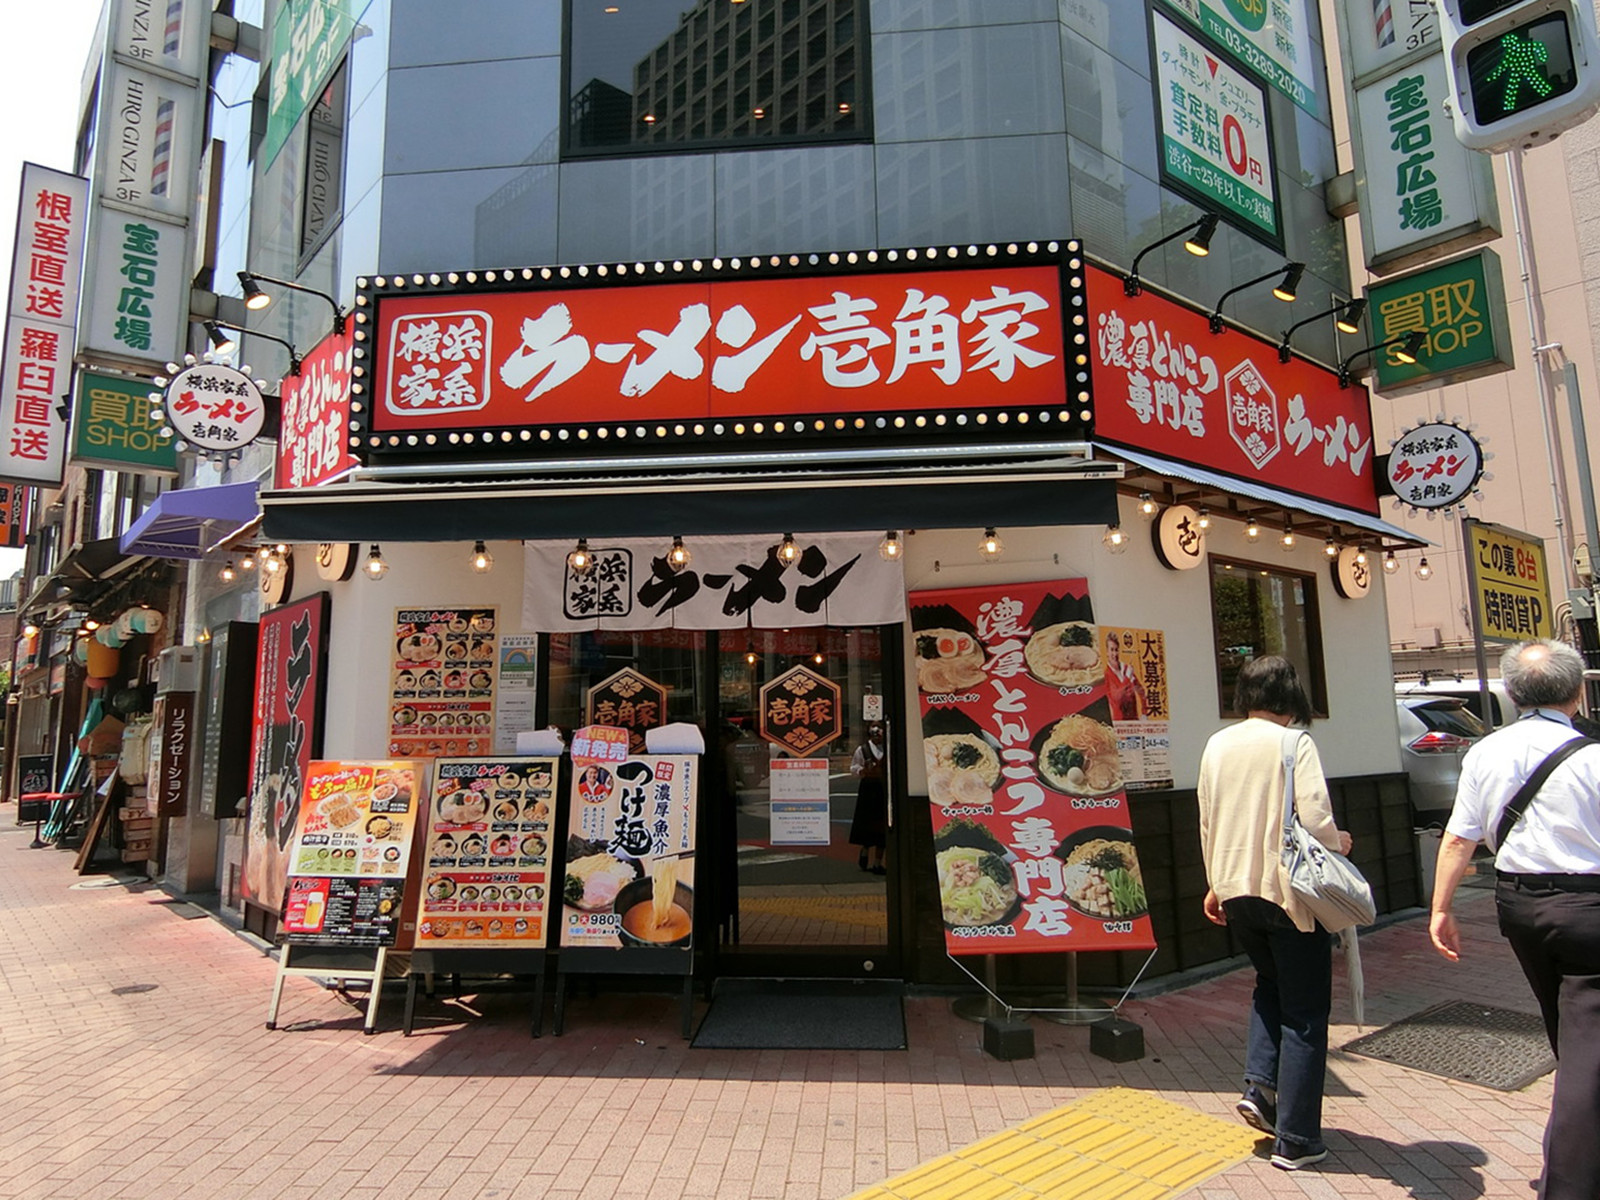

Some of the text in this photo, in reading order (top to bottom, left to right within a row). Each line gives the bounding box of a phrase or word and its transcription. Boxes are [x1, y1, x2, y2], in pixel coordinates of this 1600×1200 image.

[129, 45, 154, 59] 3F
[1406, 24, 1433, 51] 3F
[1225, 27, 1306, 105] 03-3289-2020
[1169, 79, 1220, 132] 査定料
[118, 78, 144, 190] HIROGINZA
[1172, 108, 1222, 161] 手数料
[1384, 73, 1443, 231] 宝石広場
[116, 187, 140, 201] 3F
[1168, 144, 1275, 227] 渋谷で25年以上の実績
[25, 189, 73, 319] 根室直送
[113, 222, 160, 351] 宝石広場
[1379, 278, 1481, 344] 買取
[396, 317, 484, 364] 横浜
[499, 285, 1056, 403] ラーメン 壱角家
[1097, 310, 1219, 395] 濃厚とんこつ
[173, 390, 260, 424] ラーメン
[186, 373, 249, 398] 横浜家系
[398, 361, 478, 407] 家系
[1126, 370, 1206, 438] 専門店
[89, 387, 166, 429] 買取
[191, 421, 240, 442] 壱角家
[1231, 391, 1274, 434] 壱角家
[86, 425, 171, 452] SHOP
[290, 409, 343, 488] 専門店
[1400, 434, 1460, 457] 横浜家系
[1392, 454, 1470, 485] ラーメン
[1409, 482, 1454, 501] 壱角家
[637, 545, 862, 617] ラーメン
[1478, 539, 1539, 583] この裏8台
[570, 583, 624, 614] 家系
[1483, 588, 1543, 638] 時間貸P
[1141, 632, 1163, 717] 大募集
[586, 728, 619, 741] NEW
[594, 700, 658, 727] 壱角家
[768, 697, 833, 726] 壱角家
[167, 708, 187, 804] リラクゼーション
[573, 738, 628, 761] 新発売
[976, 597, 1072, 937] 濃厚とんこつ専門店
[608, 761, 653, 857] つけ麺
[652, 783, 672, 855] 濃厚魚介
[590, 914, 615, 925] 980
